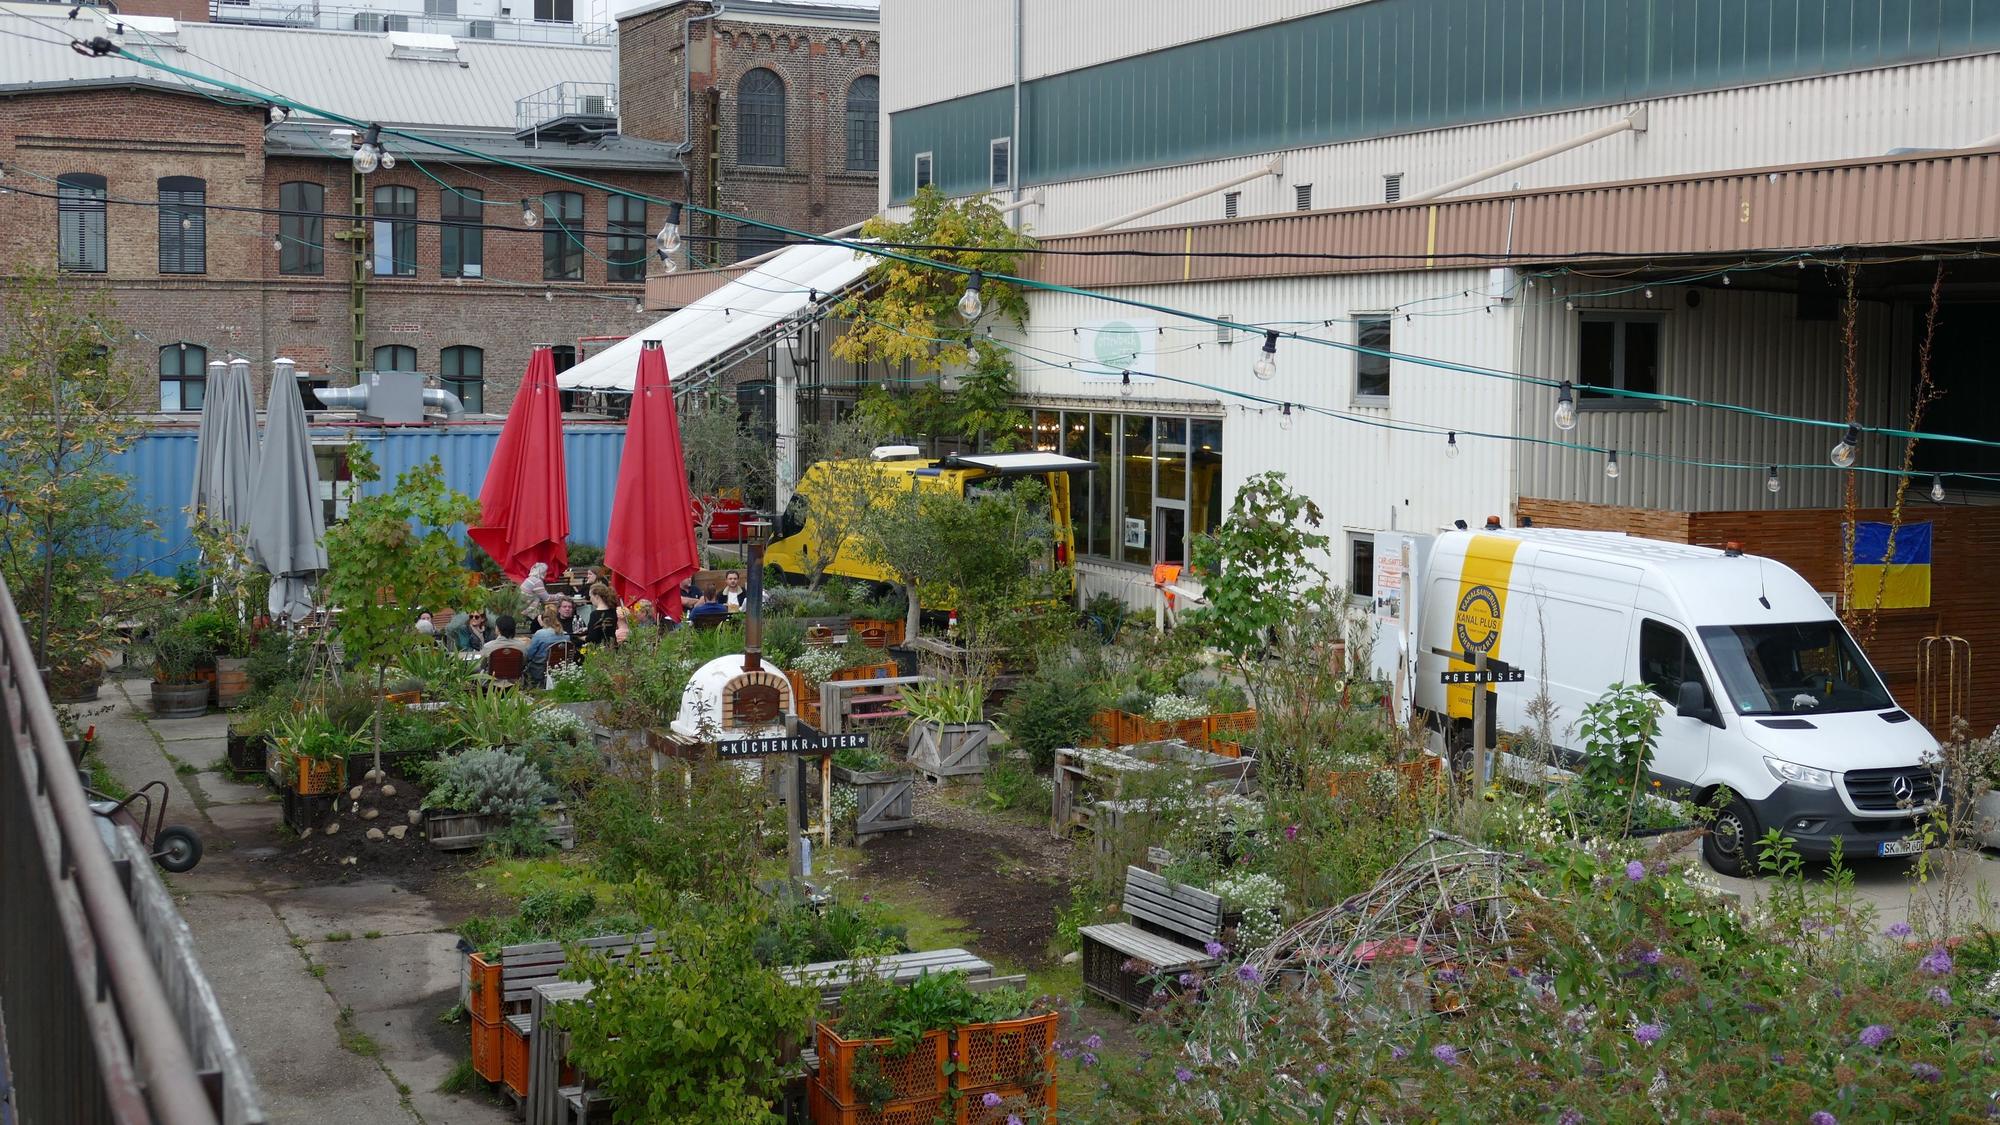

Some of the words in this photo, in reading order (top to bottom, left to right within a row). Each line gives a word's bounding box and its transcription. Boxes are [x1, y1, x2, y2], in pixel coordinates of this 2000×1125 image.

[1740, 201, 1750, 224] 3
[1457, 612, 1478, 626] KANAL
[1480, 617, 1498, 630] PLUS
[1884, 843, 1895, 853] SK
